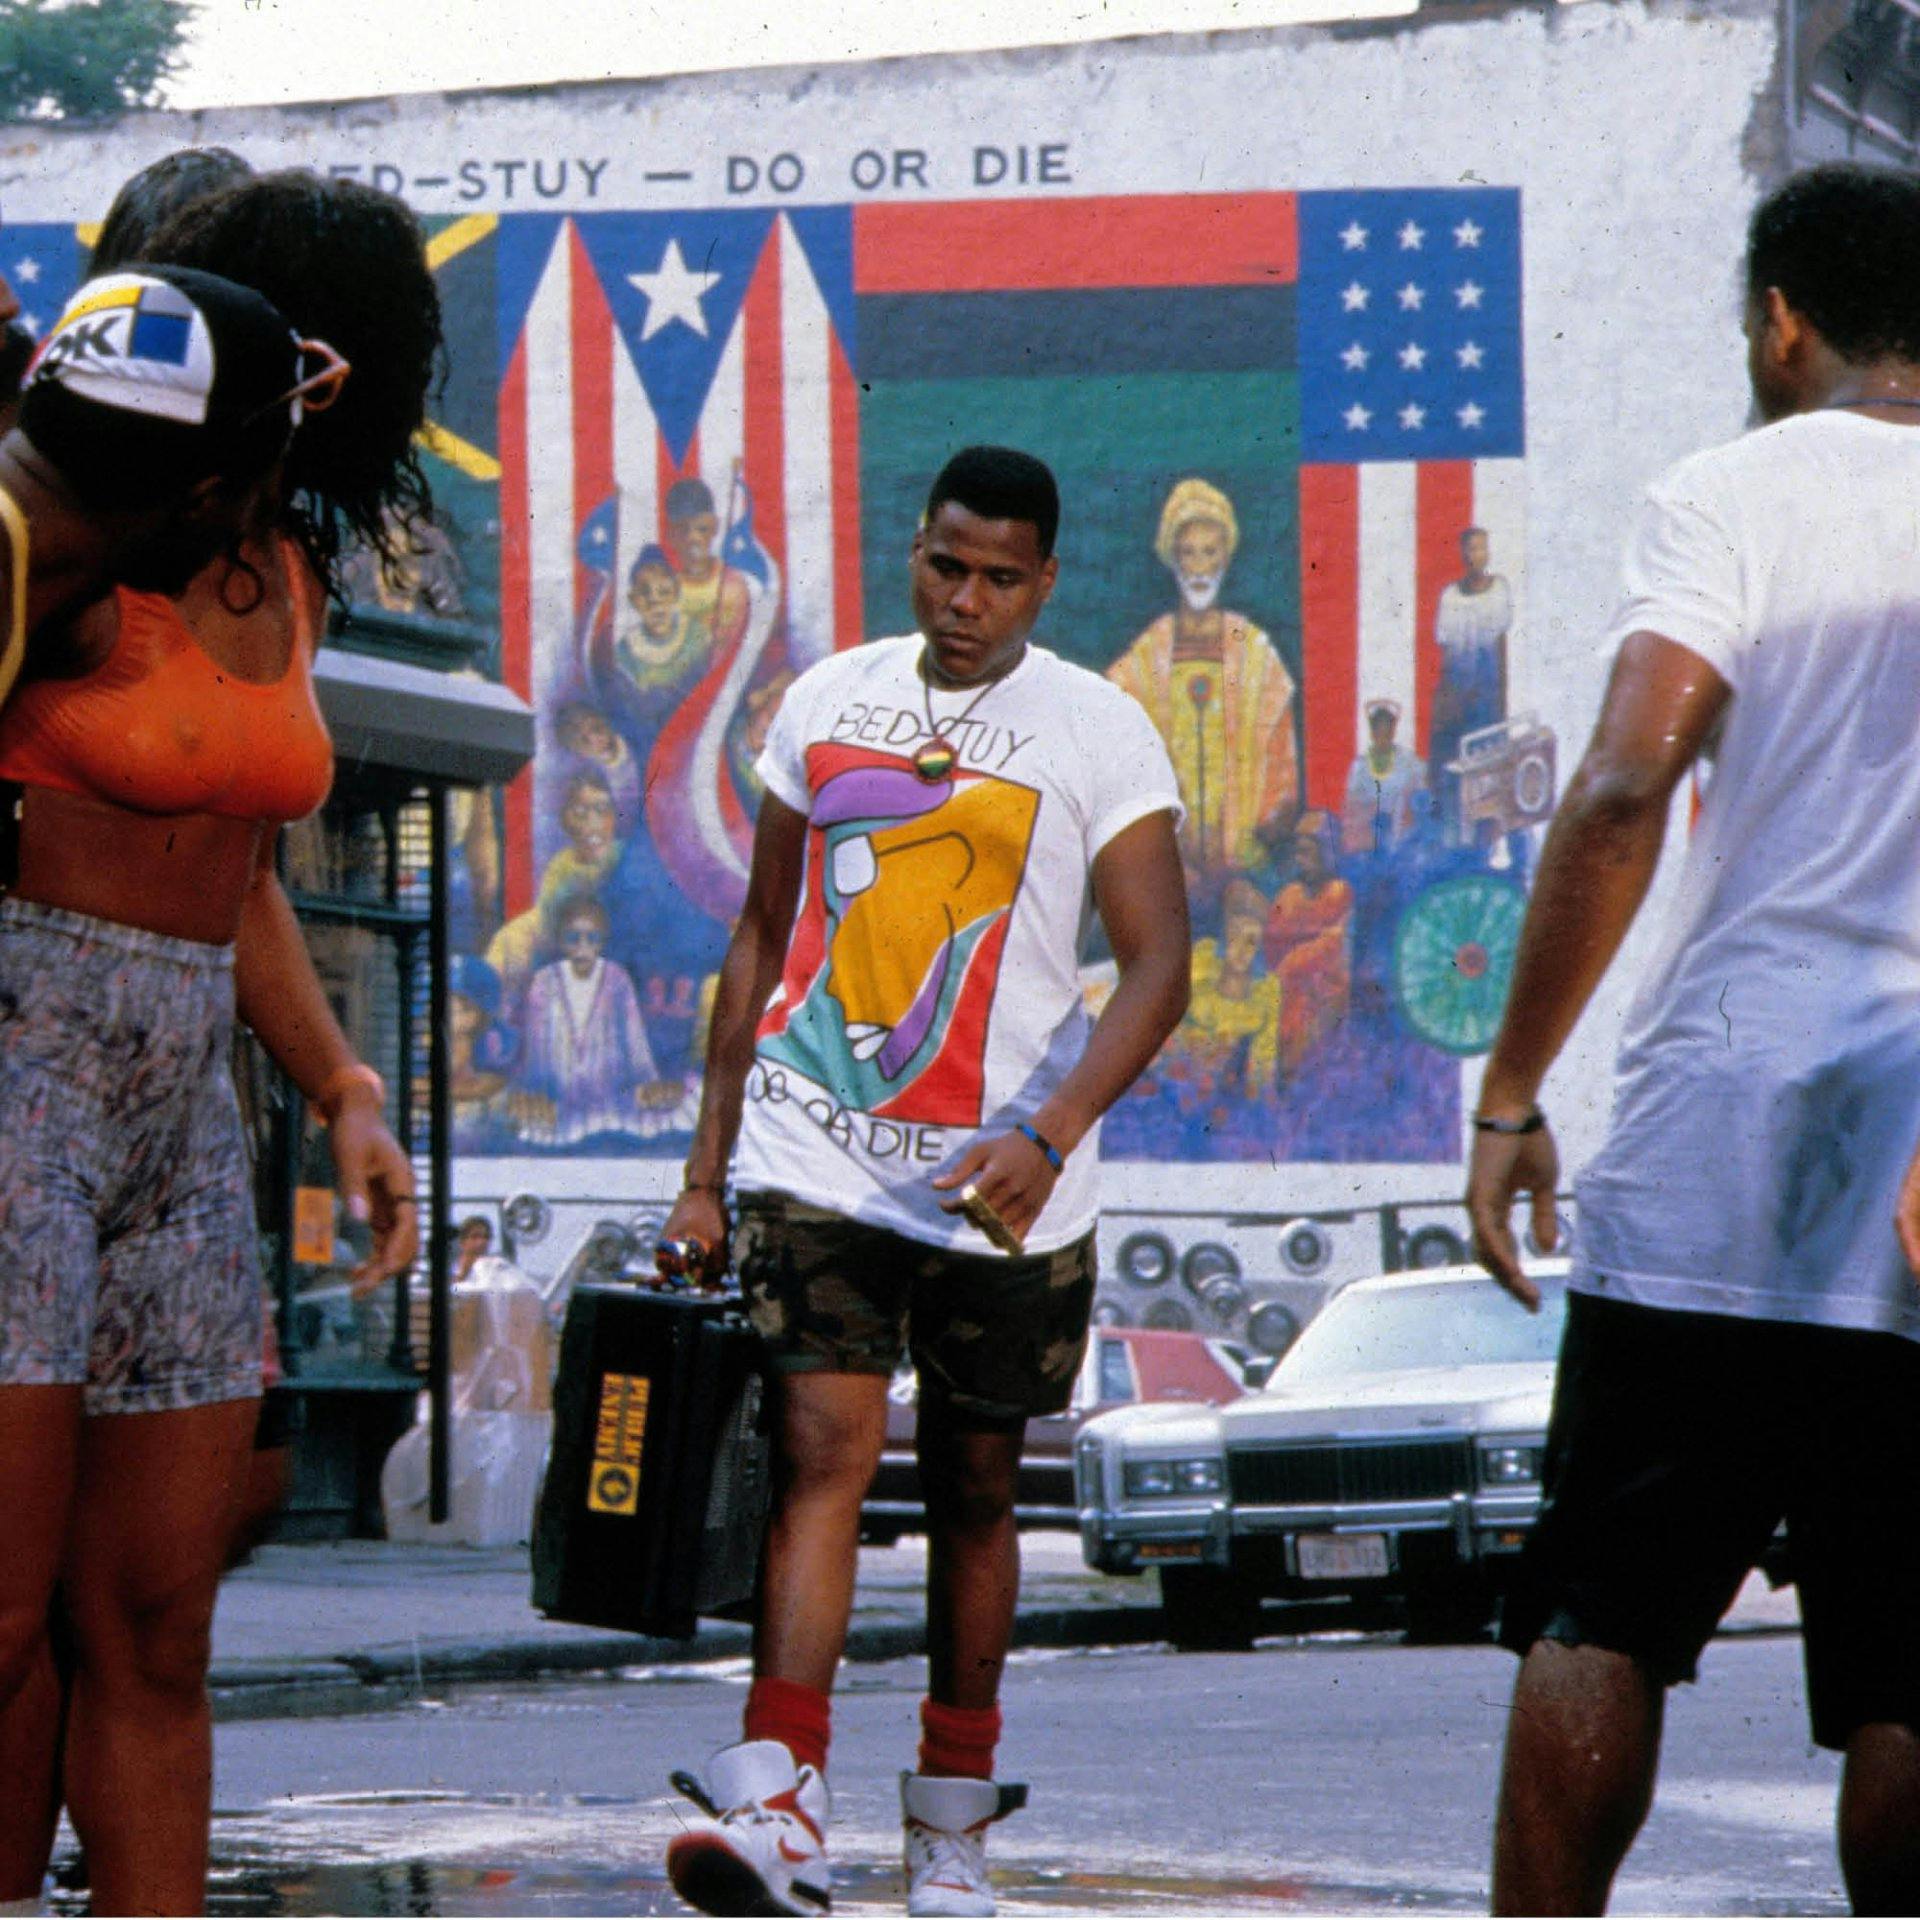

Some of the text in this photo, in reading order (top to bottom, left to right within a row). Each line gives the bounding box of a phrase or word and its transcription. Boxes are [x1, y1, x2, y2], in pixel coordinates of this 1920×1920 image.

[726, 151, 805, 195] DO
[850, 148, 929, 190] OR
[973, 143, 1072, 186] DIE
[867, 1120, 946, 1162] DIE
